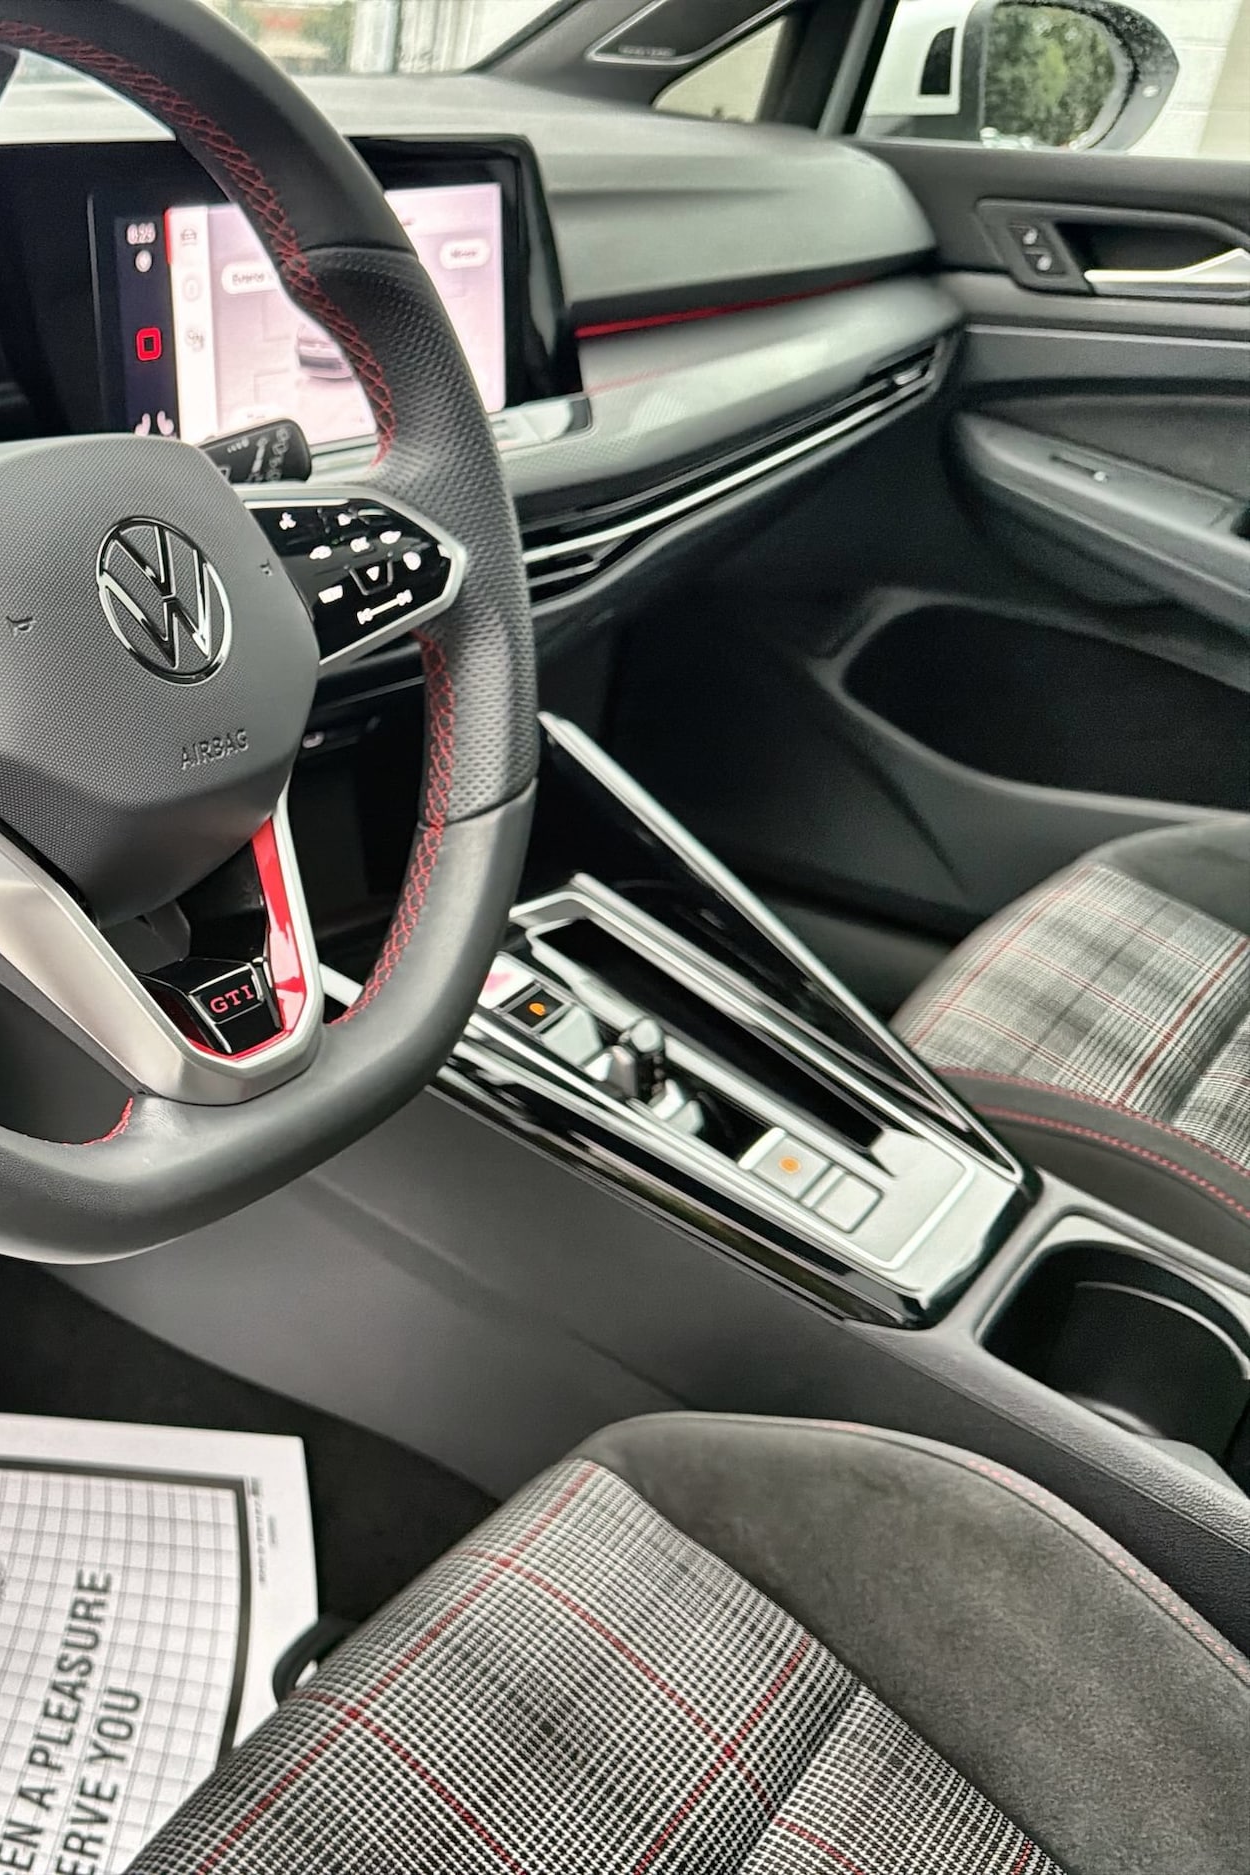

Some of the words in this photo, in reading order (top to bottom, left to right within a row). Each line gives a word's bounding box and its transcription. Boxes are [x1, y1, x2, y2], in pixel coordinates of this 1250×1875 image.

[181, 728, 249, 770] AIRBAG
[210, 984, 255, 1014] GTI
[28, 1567, 112, 1774] PLEASURE
[17, 1785, 55, 1812] A
[53, 1776, 120, 1875] ERVE
[88, 1686, 142, 1763] YOU
